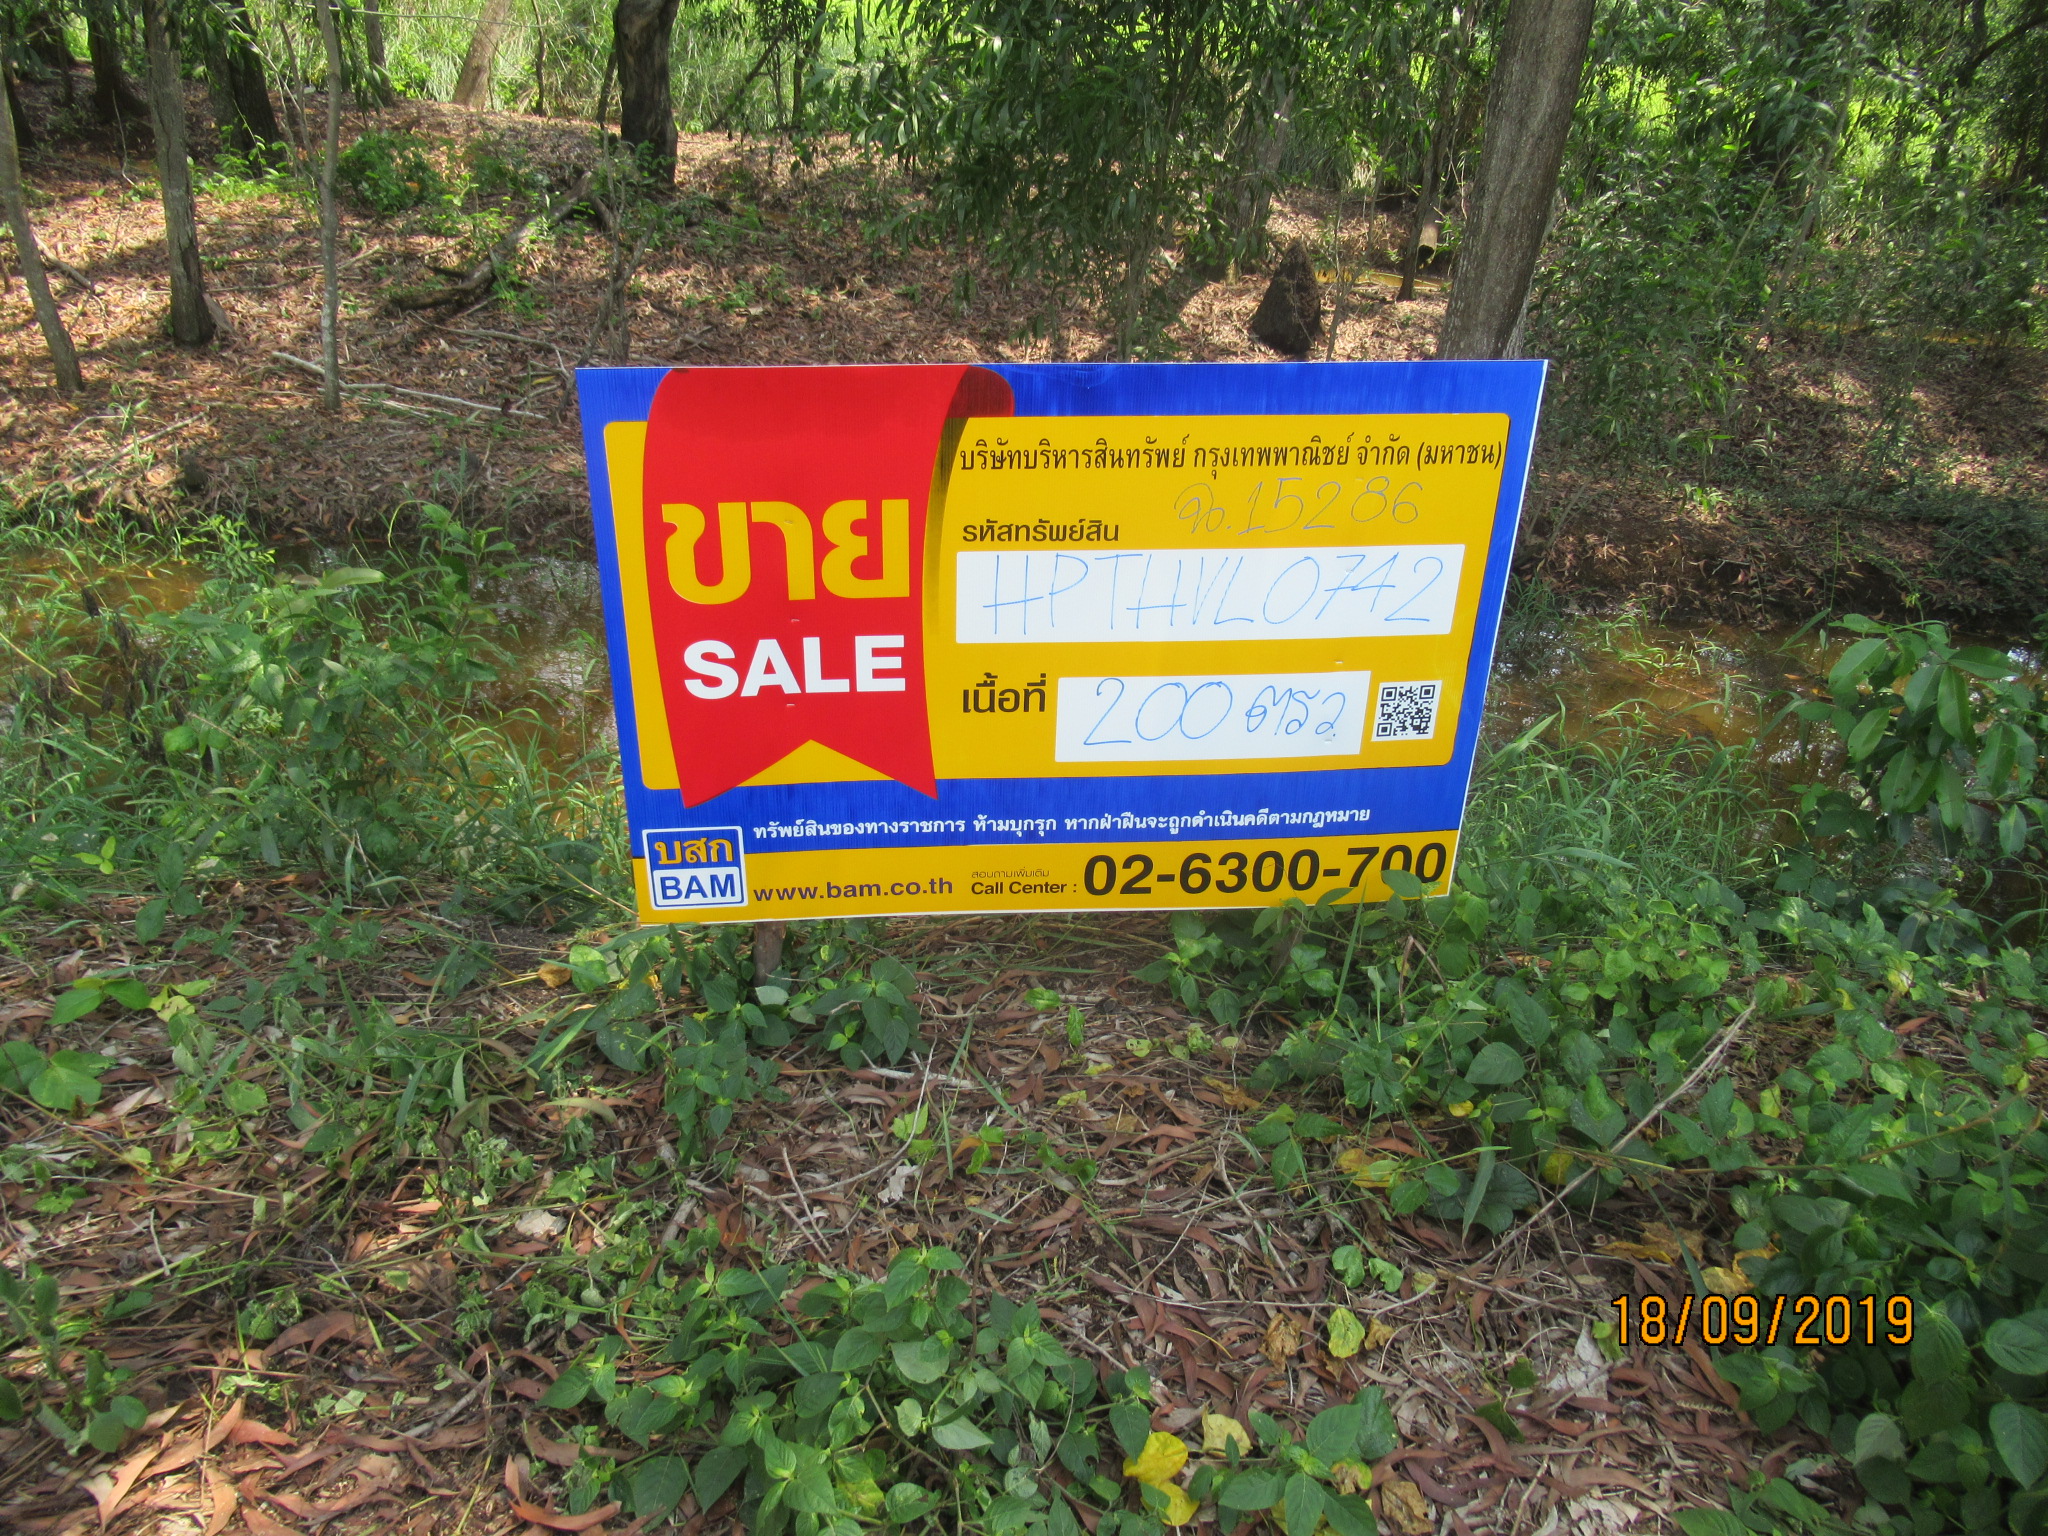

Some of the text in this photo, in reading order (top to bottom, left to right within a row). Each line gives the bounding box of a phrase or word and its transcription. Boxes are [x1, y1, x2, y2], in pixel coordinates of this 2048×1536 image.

[960, 432, 1502, 480] บริษัทบริหารสินทรัพย์ กรุงเทพพาณิชย์ จำกัด (มหาชน)
[962, 518, 1120, 543] รหัสทรัพย์สิน
[661, 498, 910, 605] ขาย
[683, 634, 906, 700] SALE
[962, 673, 1047, 713] เนื้อที่
[1083, 677, 1233, 746] 200
[753, 818, 966, 839] ทรัพย์สินของทางราชการ
[973, 814, 1057, 838] ห้ามบุกรุก
[654, 837, 734, 865] บสก
[659, 873, 737, 901] BAM
[753, 877, 954, 902] www.bam.co.th
[970, 881, 1004, 895] Call
[1008, 881, 1067, 894] Center
